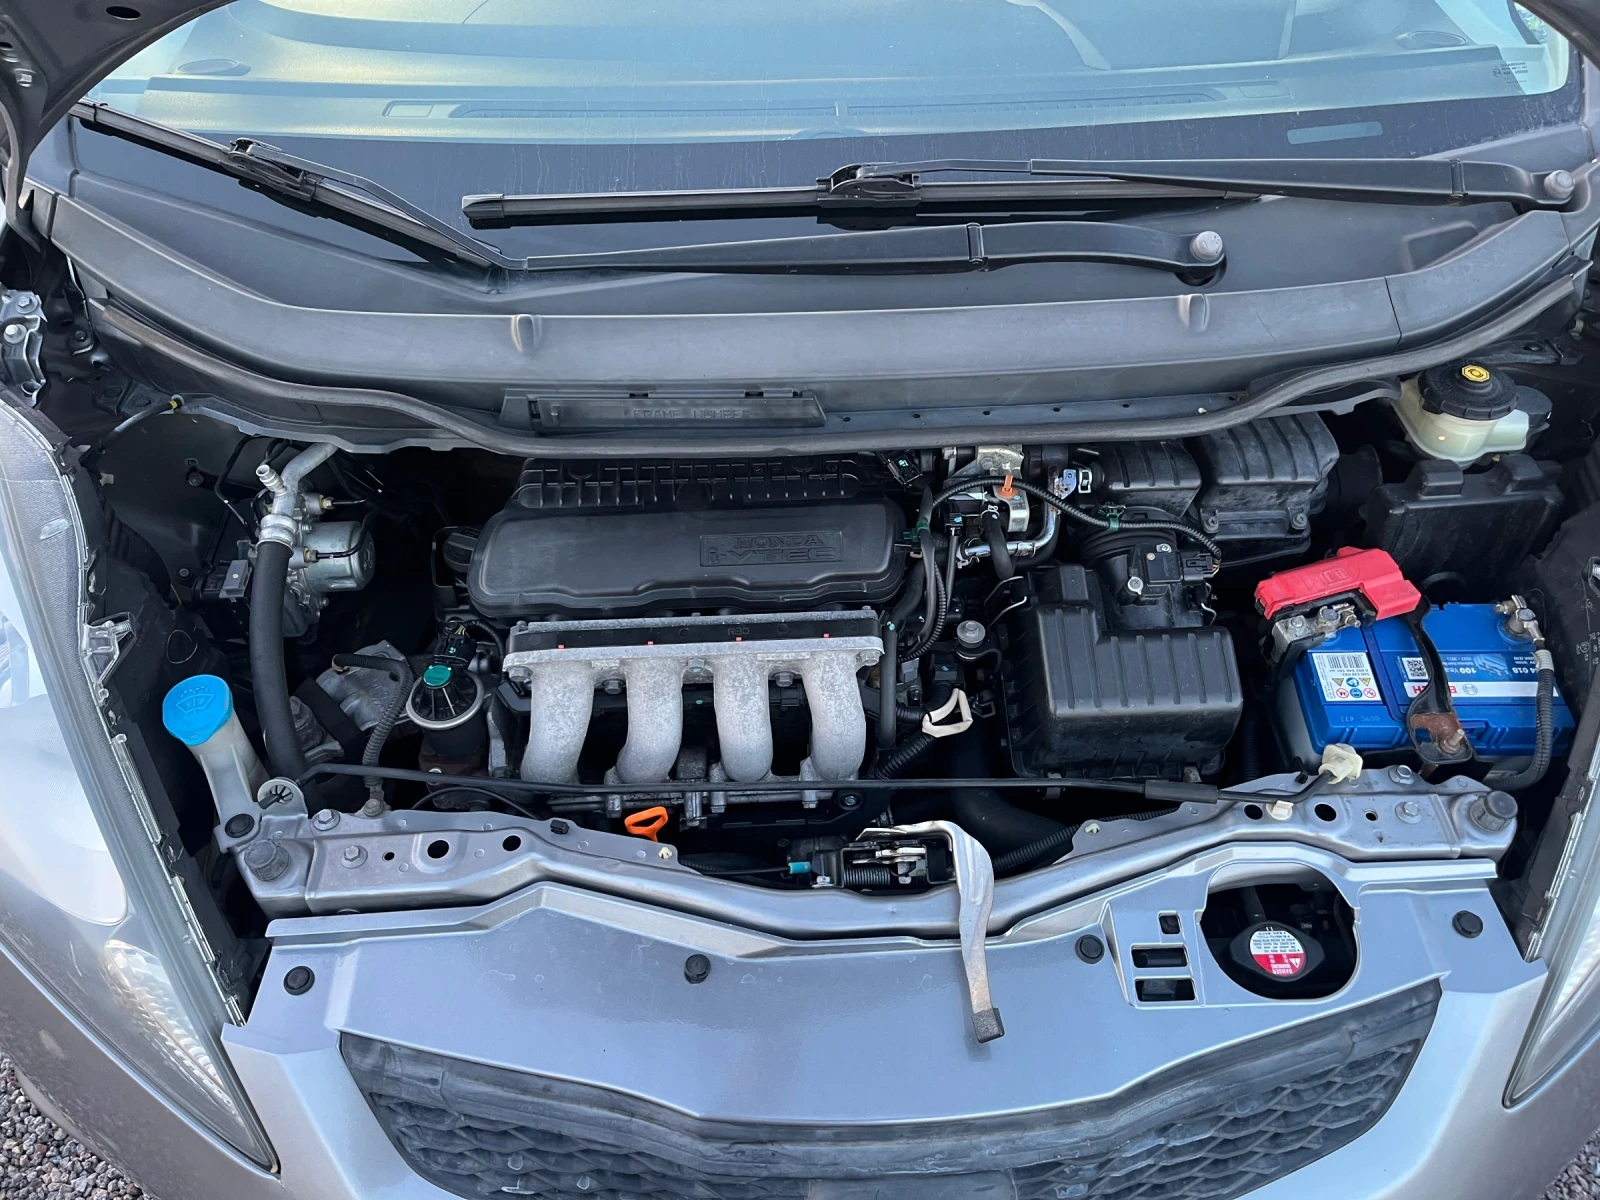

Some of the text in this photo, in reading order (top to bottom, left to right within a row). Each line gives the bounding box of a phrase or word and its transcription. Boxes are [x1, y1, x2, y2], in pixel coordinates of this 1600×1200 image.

[633, 408, 752, 419] FRAME NUMBER
[734, 535, 827, 549] HONDA
[709, 548, 836, 564] i-VTEC
